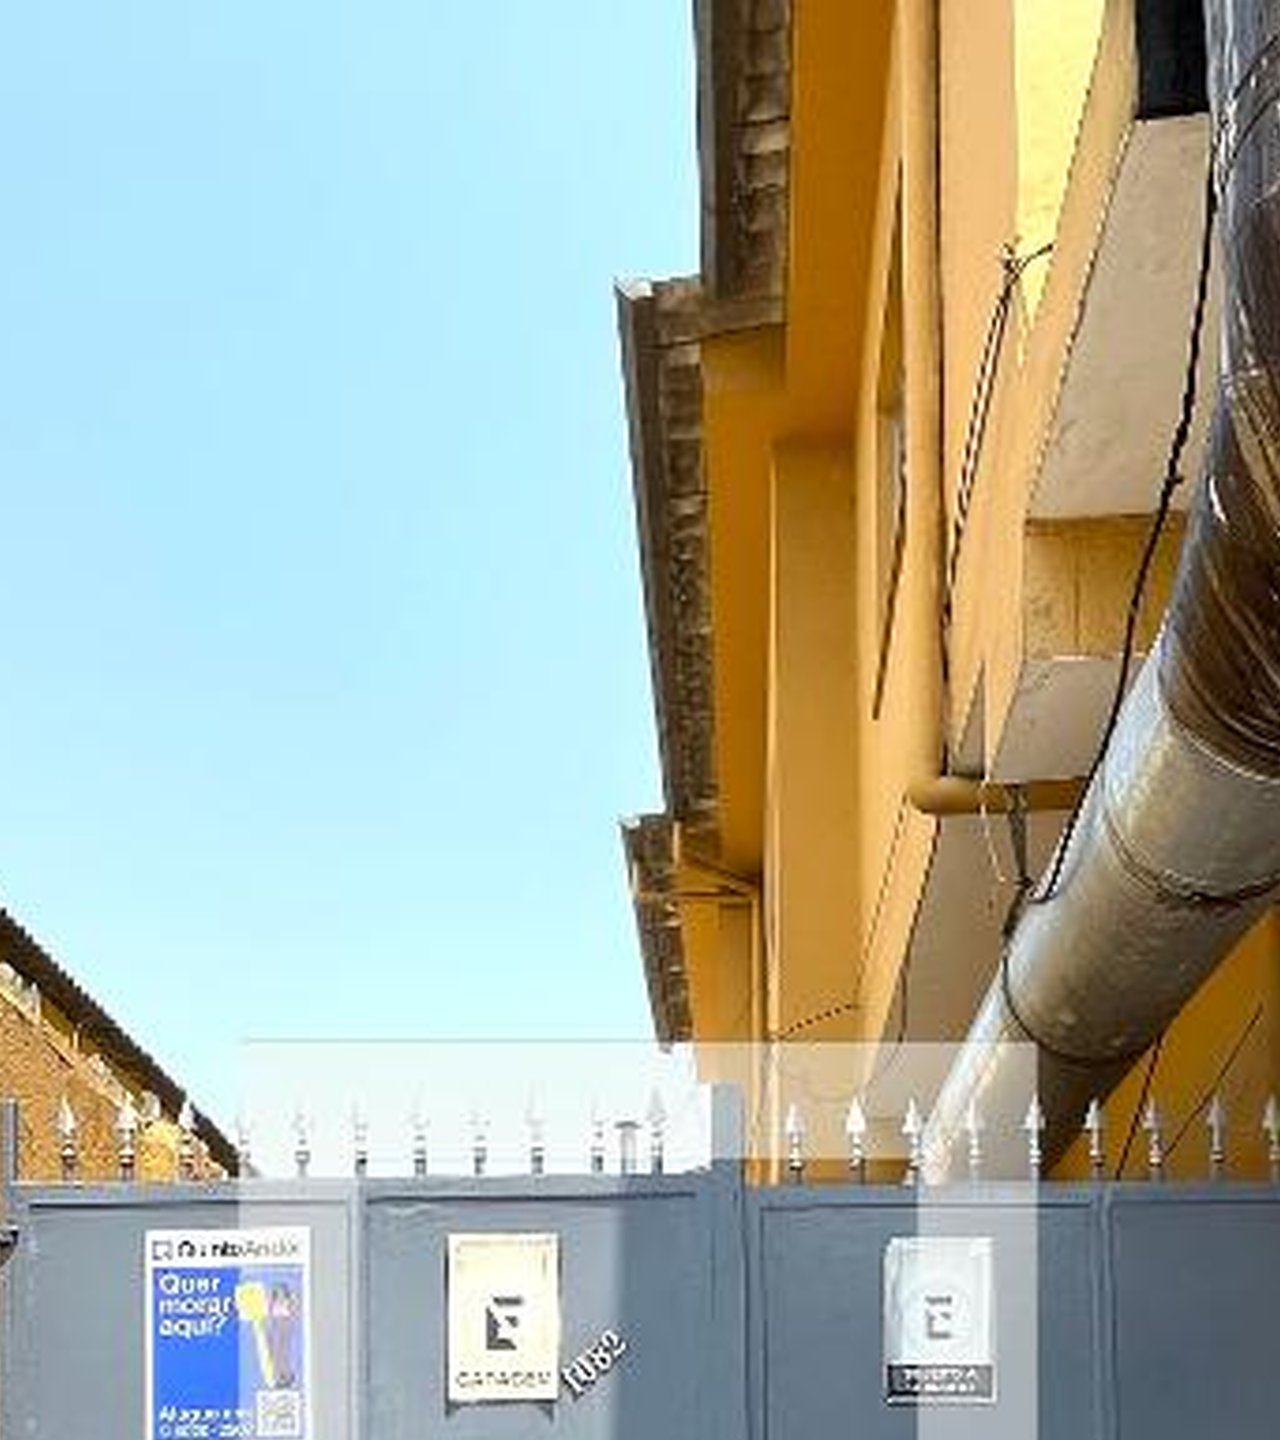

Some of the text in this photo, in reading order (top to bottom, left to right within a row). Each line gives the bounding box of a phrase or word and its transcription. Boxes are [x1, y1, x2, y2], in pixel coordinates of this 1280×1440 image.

[159, 1273, 221, 1295] Quer
[159, 1296, 233, 1315] morar
[159, 1317, 229, 1339] aqui?
